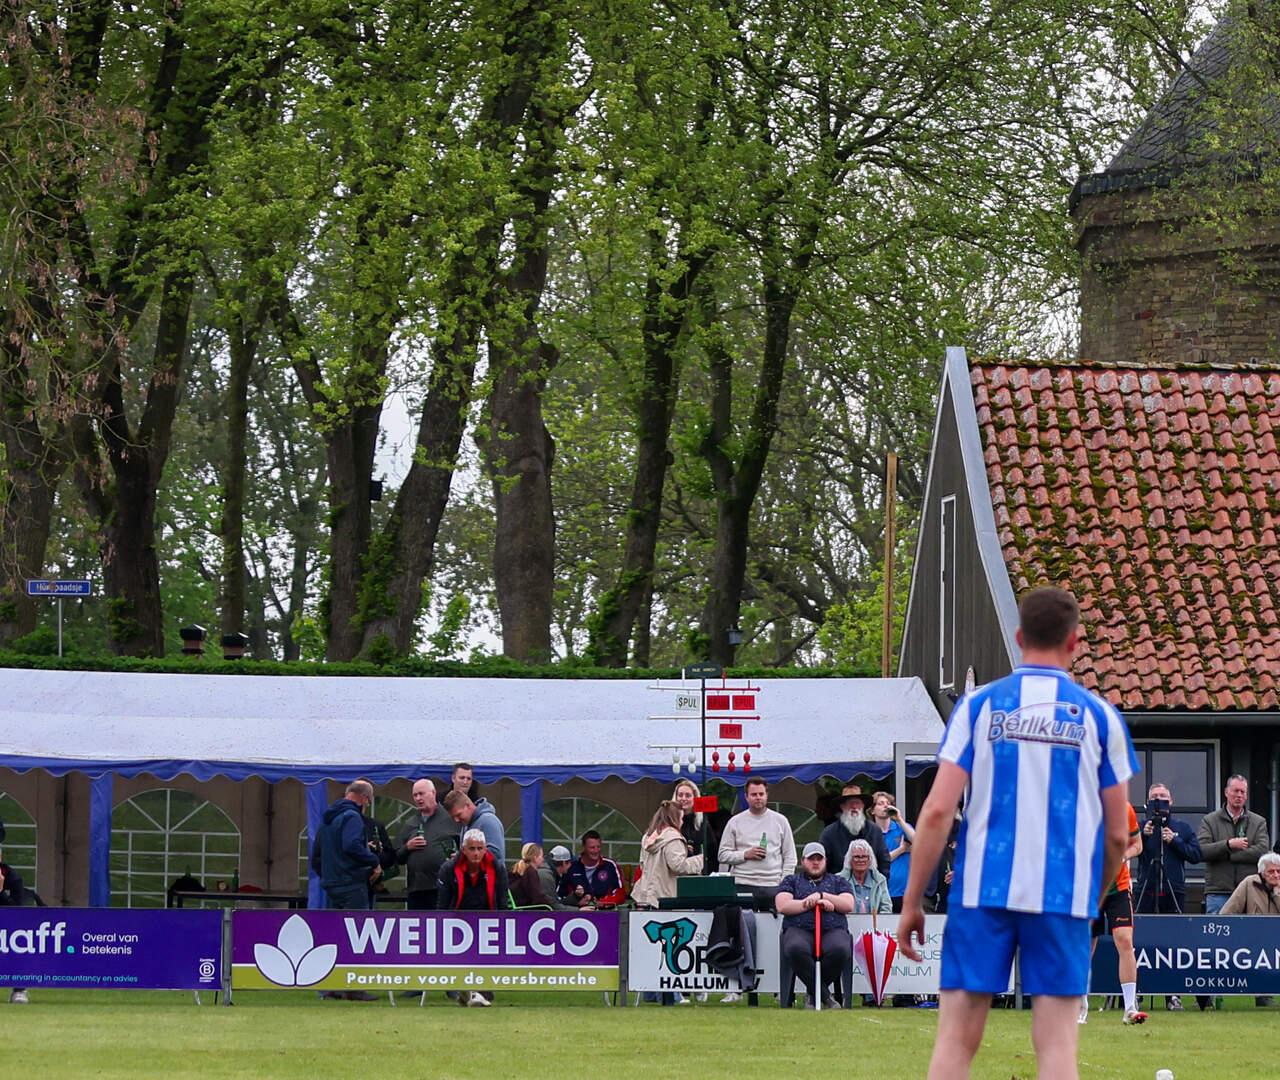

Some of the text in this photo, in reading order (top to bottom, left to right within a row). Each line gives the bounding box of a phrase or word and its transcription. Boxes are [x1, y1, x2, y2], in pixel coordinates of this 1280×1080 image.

[678, 697, 697, 709] SPUL
[1202, 923, 1231, 937] 1873
[82, 932, 139, 943] Overal van
[343, 917, 599, 956] WEIDELCO
[82, 945, 133, 955] betekenis
[12, 974, 43, 983] ervaring
[52, 974, 101, 983] accountancy
[114, 975, 138, 983] advies
[346, 972, 597, 985] Partner voor de versbranche
[660, 977, 729, 990] HALLUM
[1185, 977, 1248, 987] DOKKUM
